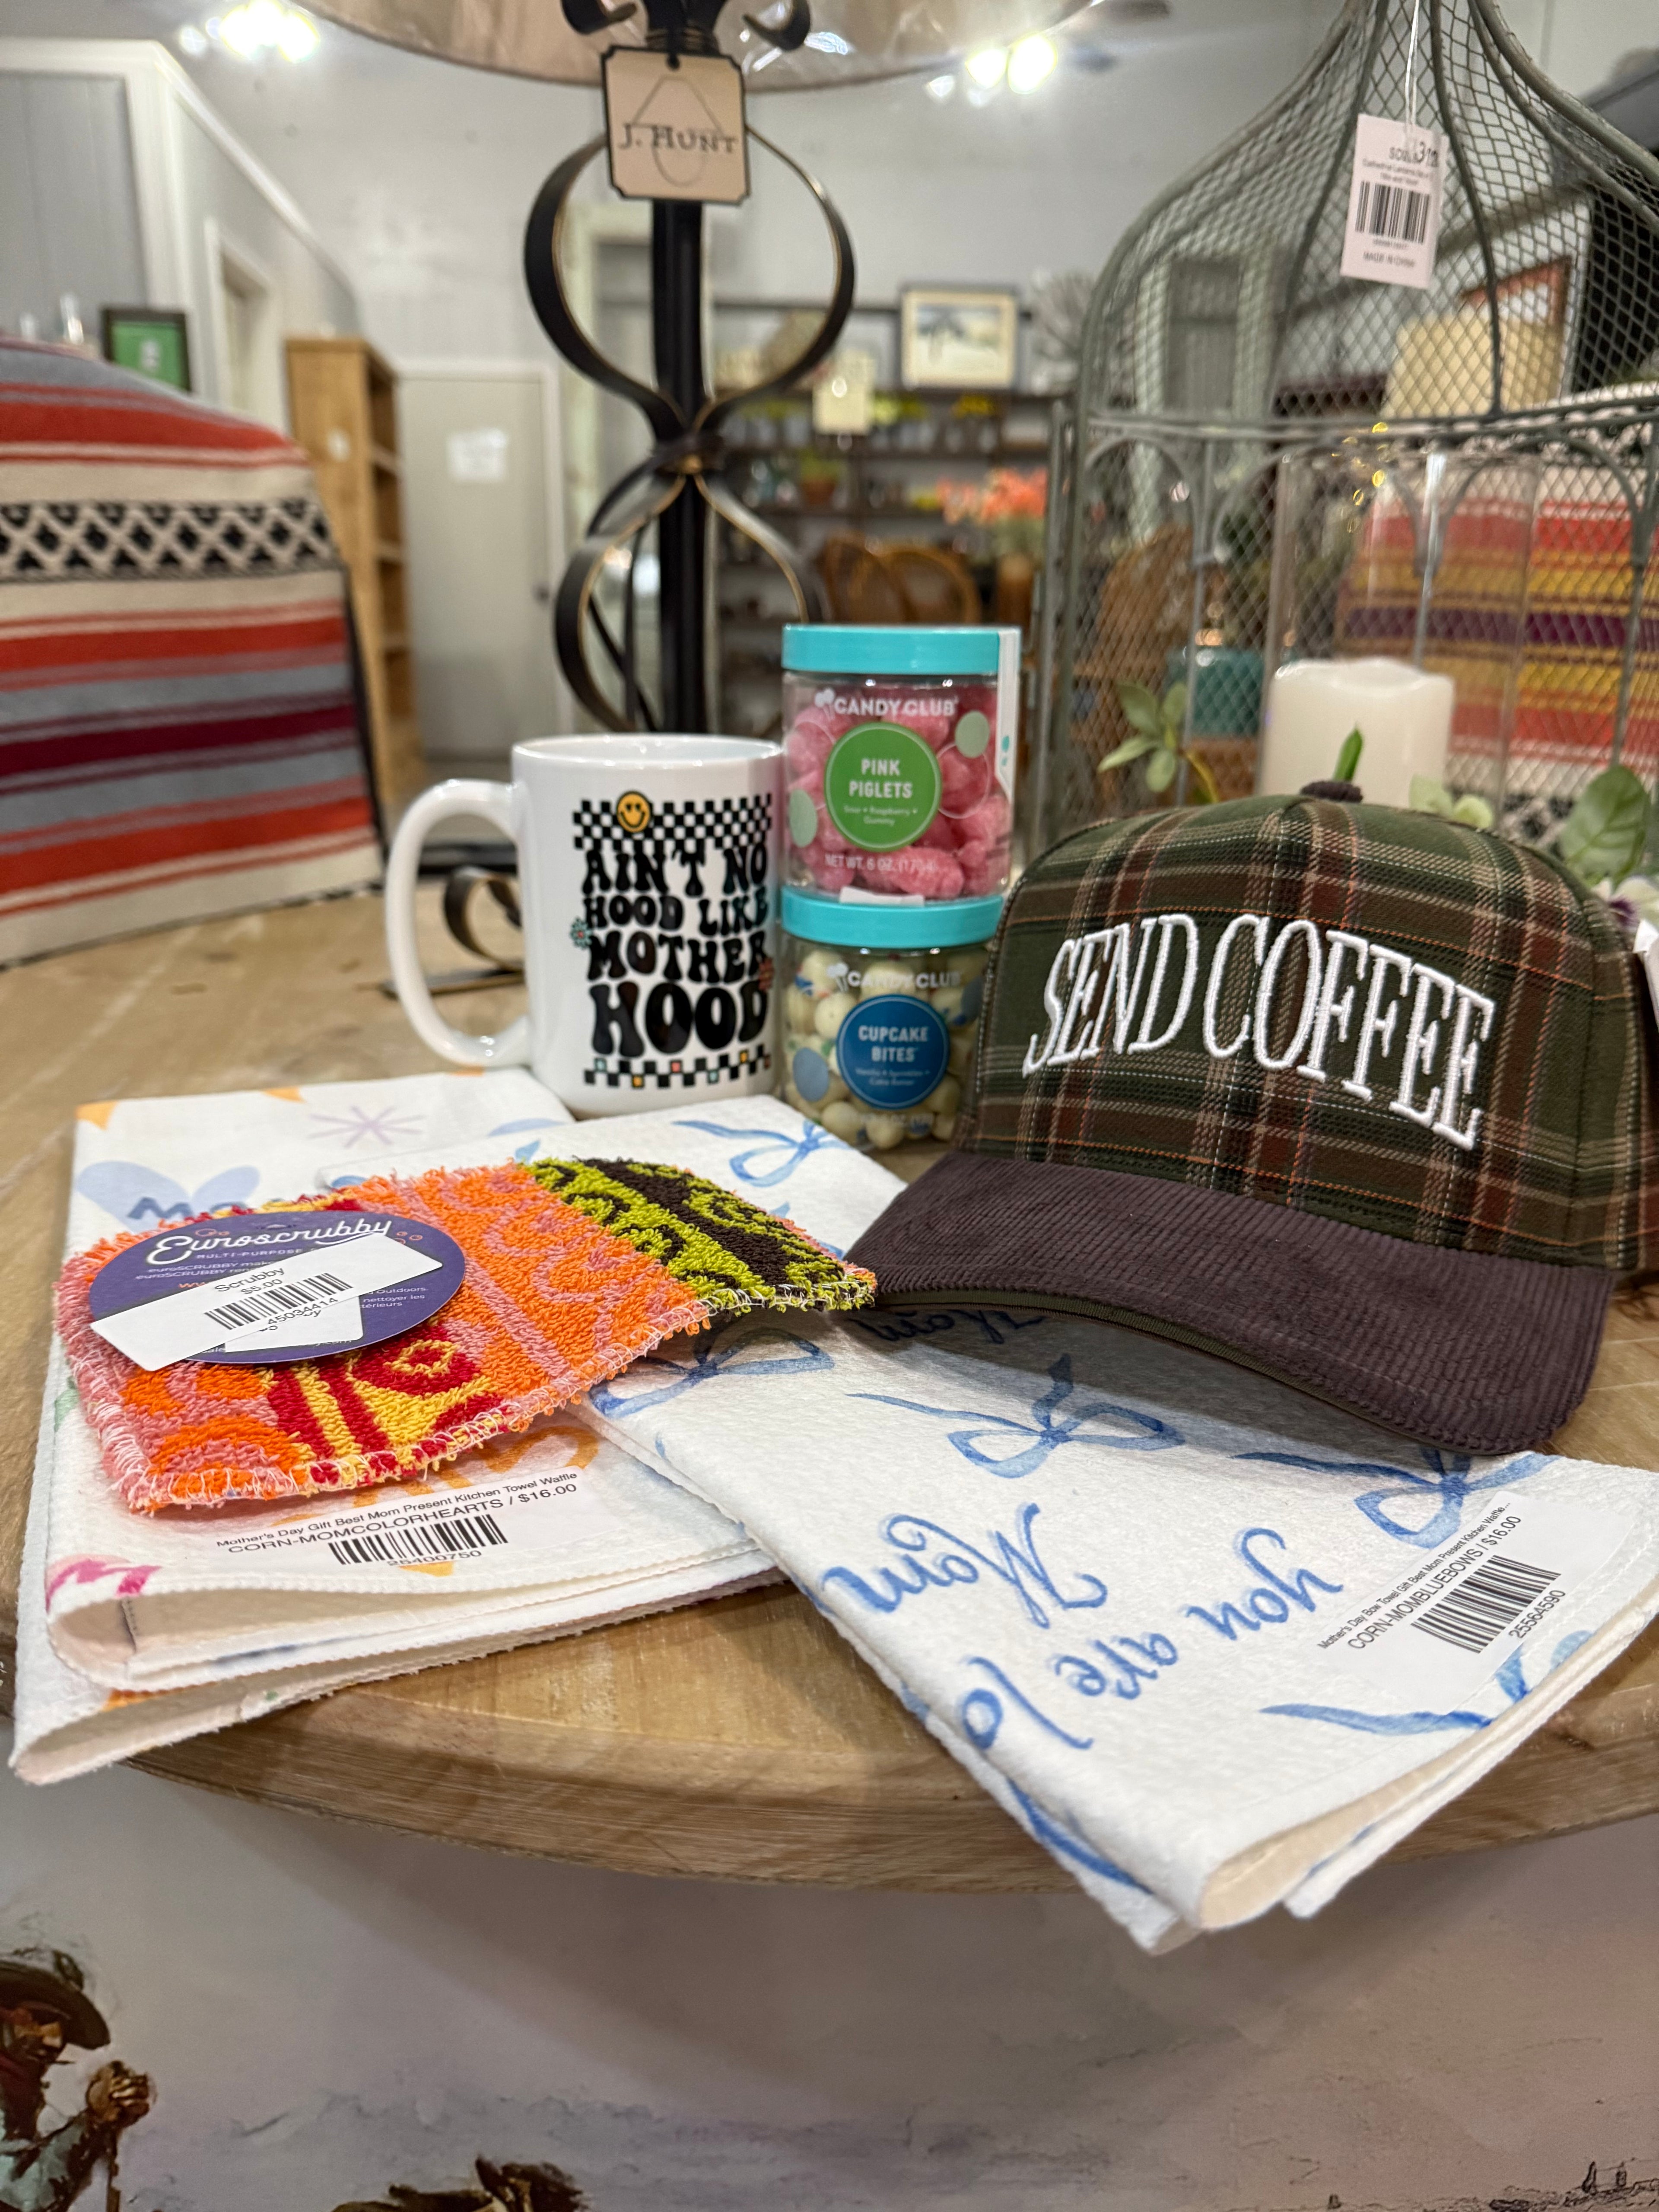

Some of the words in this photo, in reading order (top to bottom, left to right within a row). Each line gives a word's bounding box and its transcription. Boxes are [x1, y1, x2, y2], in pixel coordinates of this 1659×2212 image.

[618, 123, 642, 150] J.
[652, 124, 738, 153] HUNT
[834, 697, 901, 718] CANDY
[903, 697, 956, 717] CLUB
[861, 758, 900, 776] PINK
[849, 781, 913, 799] PIGLETS
[582, 842, 706, 897] AIN'T
[723, 842, 767, 895] NO
[825, 853, 844, 868] NET
[866, 857, 875, 871] 6
[584, 894, 684, 931] HOOD
[698, 886, 769, 936] LIKE
[588, 930, 767, 984] MOTHER
[847, 970, 913, 989] CANDY
[588, 979, 768, 1058] HOOD
[858, 1024, 928, 1042] CUPCAKE
[1022, 913, 1200, 1078] SEND
[1203, 914, 1496, 1150] COFFEE
[871, 1046, 915, 1062] BITES
[146, 1218, 392, 1265] Euroscrubby
[135, 1268, 226, 1280] euroSCRUBBY
[148, 1262, 238, 1272] euroSCRUBBY
[215, 1268, 285, 1292] Scrubby
[241, 1279, 283, 1294] $5.00
[377, 1286, 429, 1294] Outdoors.
[268, 1297, 338, 1325] 45034414
[216, 1533, 274, 1547] Mother's
[277, 1527, 304, 1537] Day
[308, 1520, 332, 1532] Gift
[334, 1515, 364, 1526] Best
[367, 1508, 400, 1520] Mom
[403, 1497, 452, 1513] Present
[454, 1489, 501, 1503] Kitchen
[502, 1481, 538, 1493] Towel
[539, 1473, 578, 1485] Waffle
[228, 1499, 504, 1553] CORN-MOMCOLORHEARTS
[518, 1484, 577, 1503] $16.00
[1180, 1528, 1344, 1640] you
[1317, 1625, 1352, 1649] Mother's
[1347, 1615, 1368, 1627] Day
[1361, 1604, 1382, 1616] Bow
[1376, 1590, 1401, 1605] Towel
[1396, 1582, 1414, 1592] Gift
[1408, 1569, 1427, 1583] Best
[1422, 1557, 1444, 1573] Mom
[1438, 1537, 1467, 1560] Present
[1461, 1523, 1488, 1542] Kitchen
[1347, 1548, 1484, 1649] CORN-MOMBLUEBOWS
[1481, 1516, 1521, 1545] $16.00
[1508, 1589, 1566, 1639] 25564590
[1052, 1632, 1179, 1700] are
